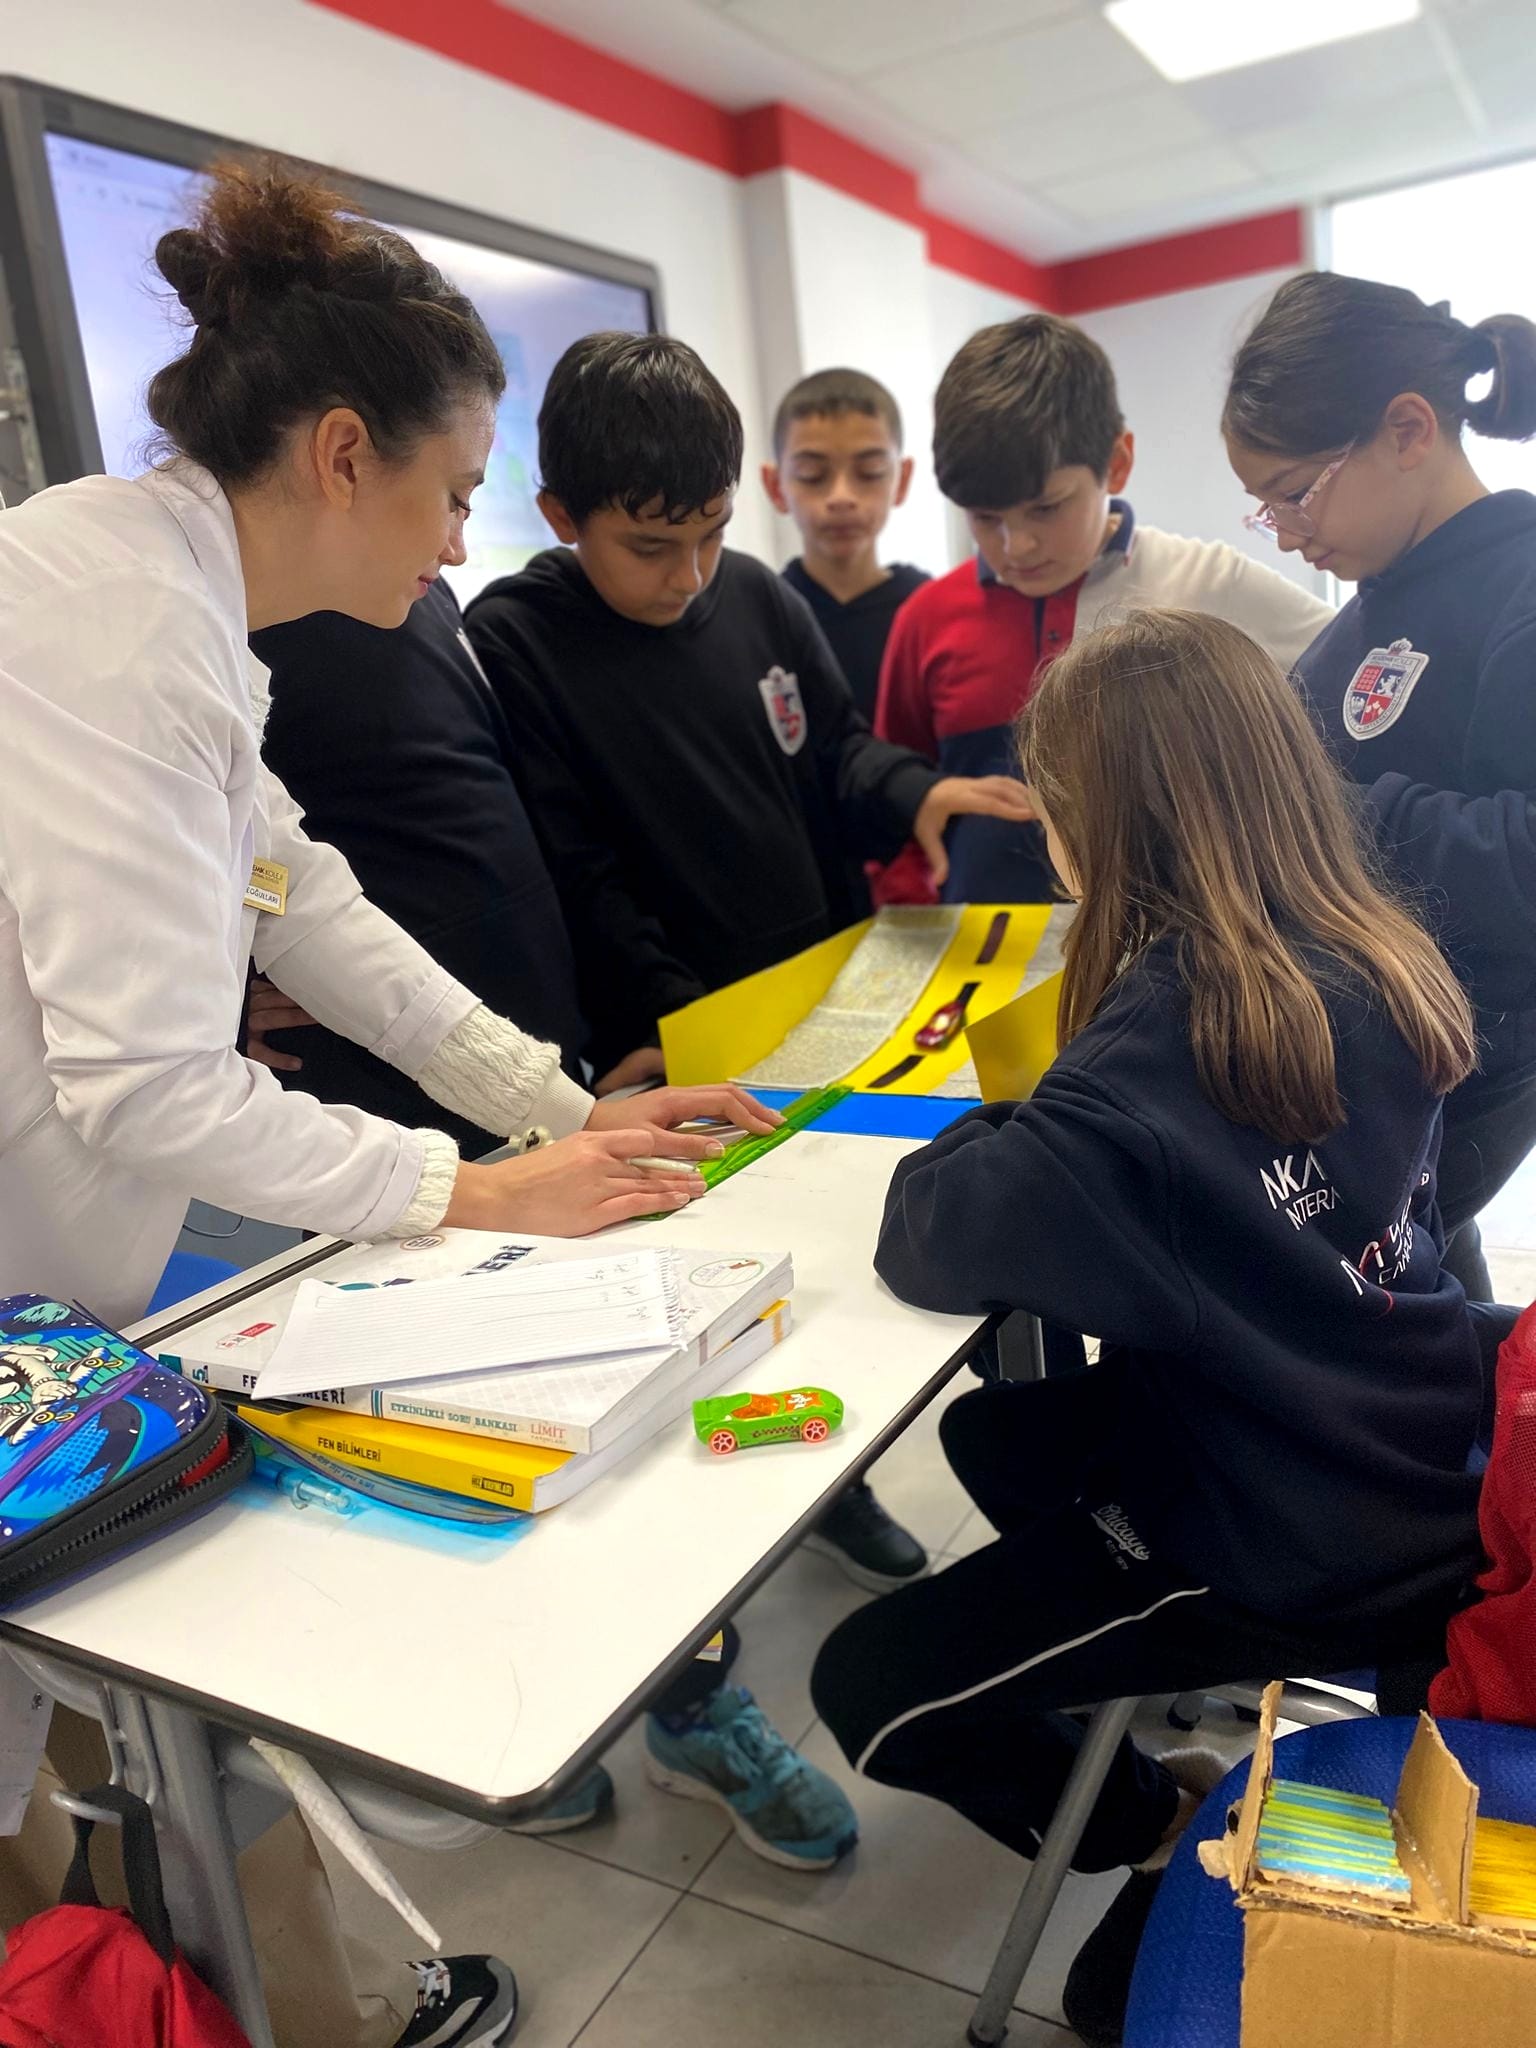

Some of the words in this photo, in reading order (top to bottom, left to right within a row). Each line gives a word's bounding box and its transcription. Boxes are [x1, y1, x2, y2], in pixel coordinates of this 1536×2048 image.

[475, 1416, 518, 1432] BANKASI
[317, 1436, 335, 1450] FEN
[336, 1441, 381, 1462] BİLİMLERİ
